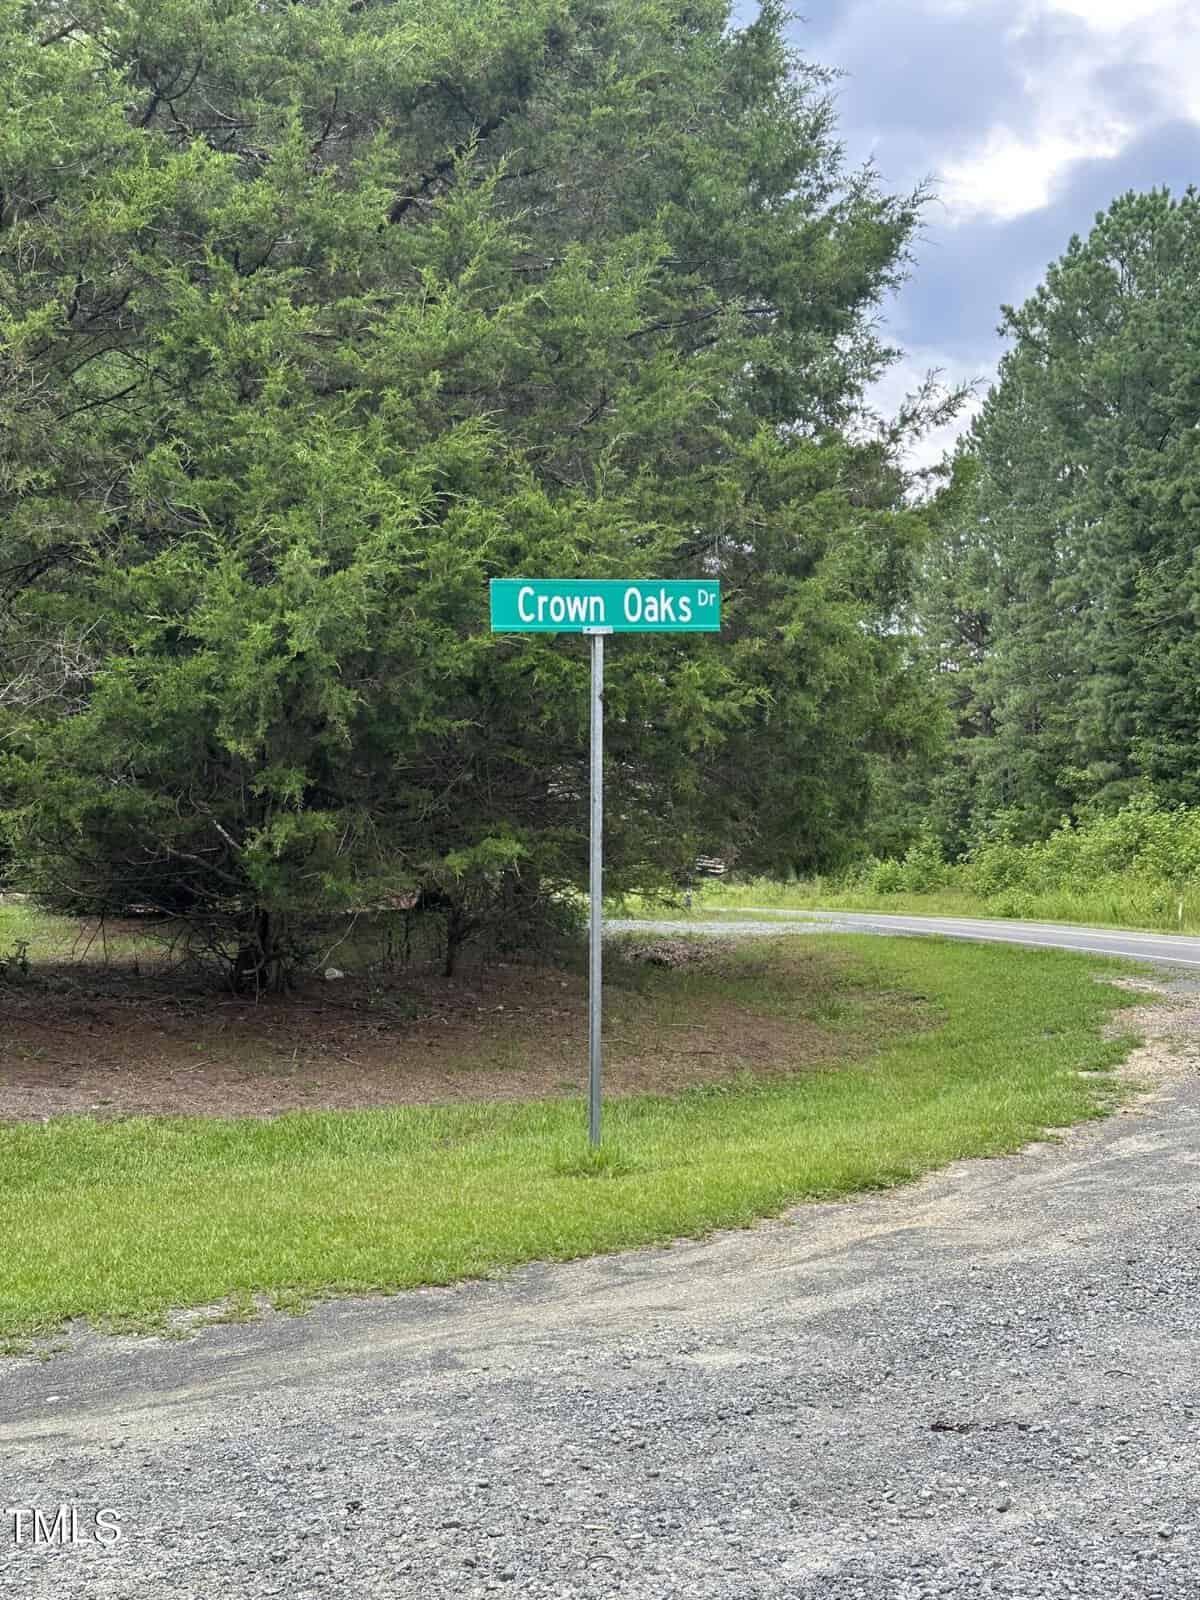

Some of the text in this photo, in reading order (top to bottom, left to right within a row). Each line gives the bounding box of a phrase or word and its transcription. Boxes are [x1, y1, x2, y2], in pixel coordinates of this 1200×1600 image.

[517, 586, 716, 623] Crown Oaks Dr
